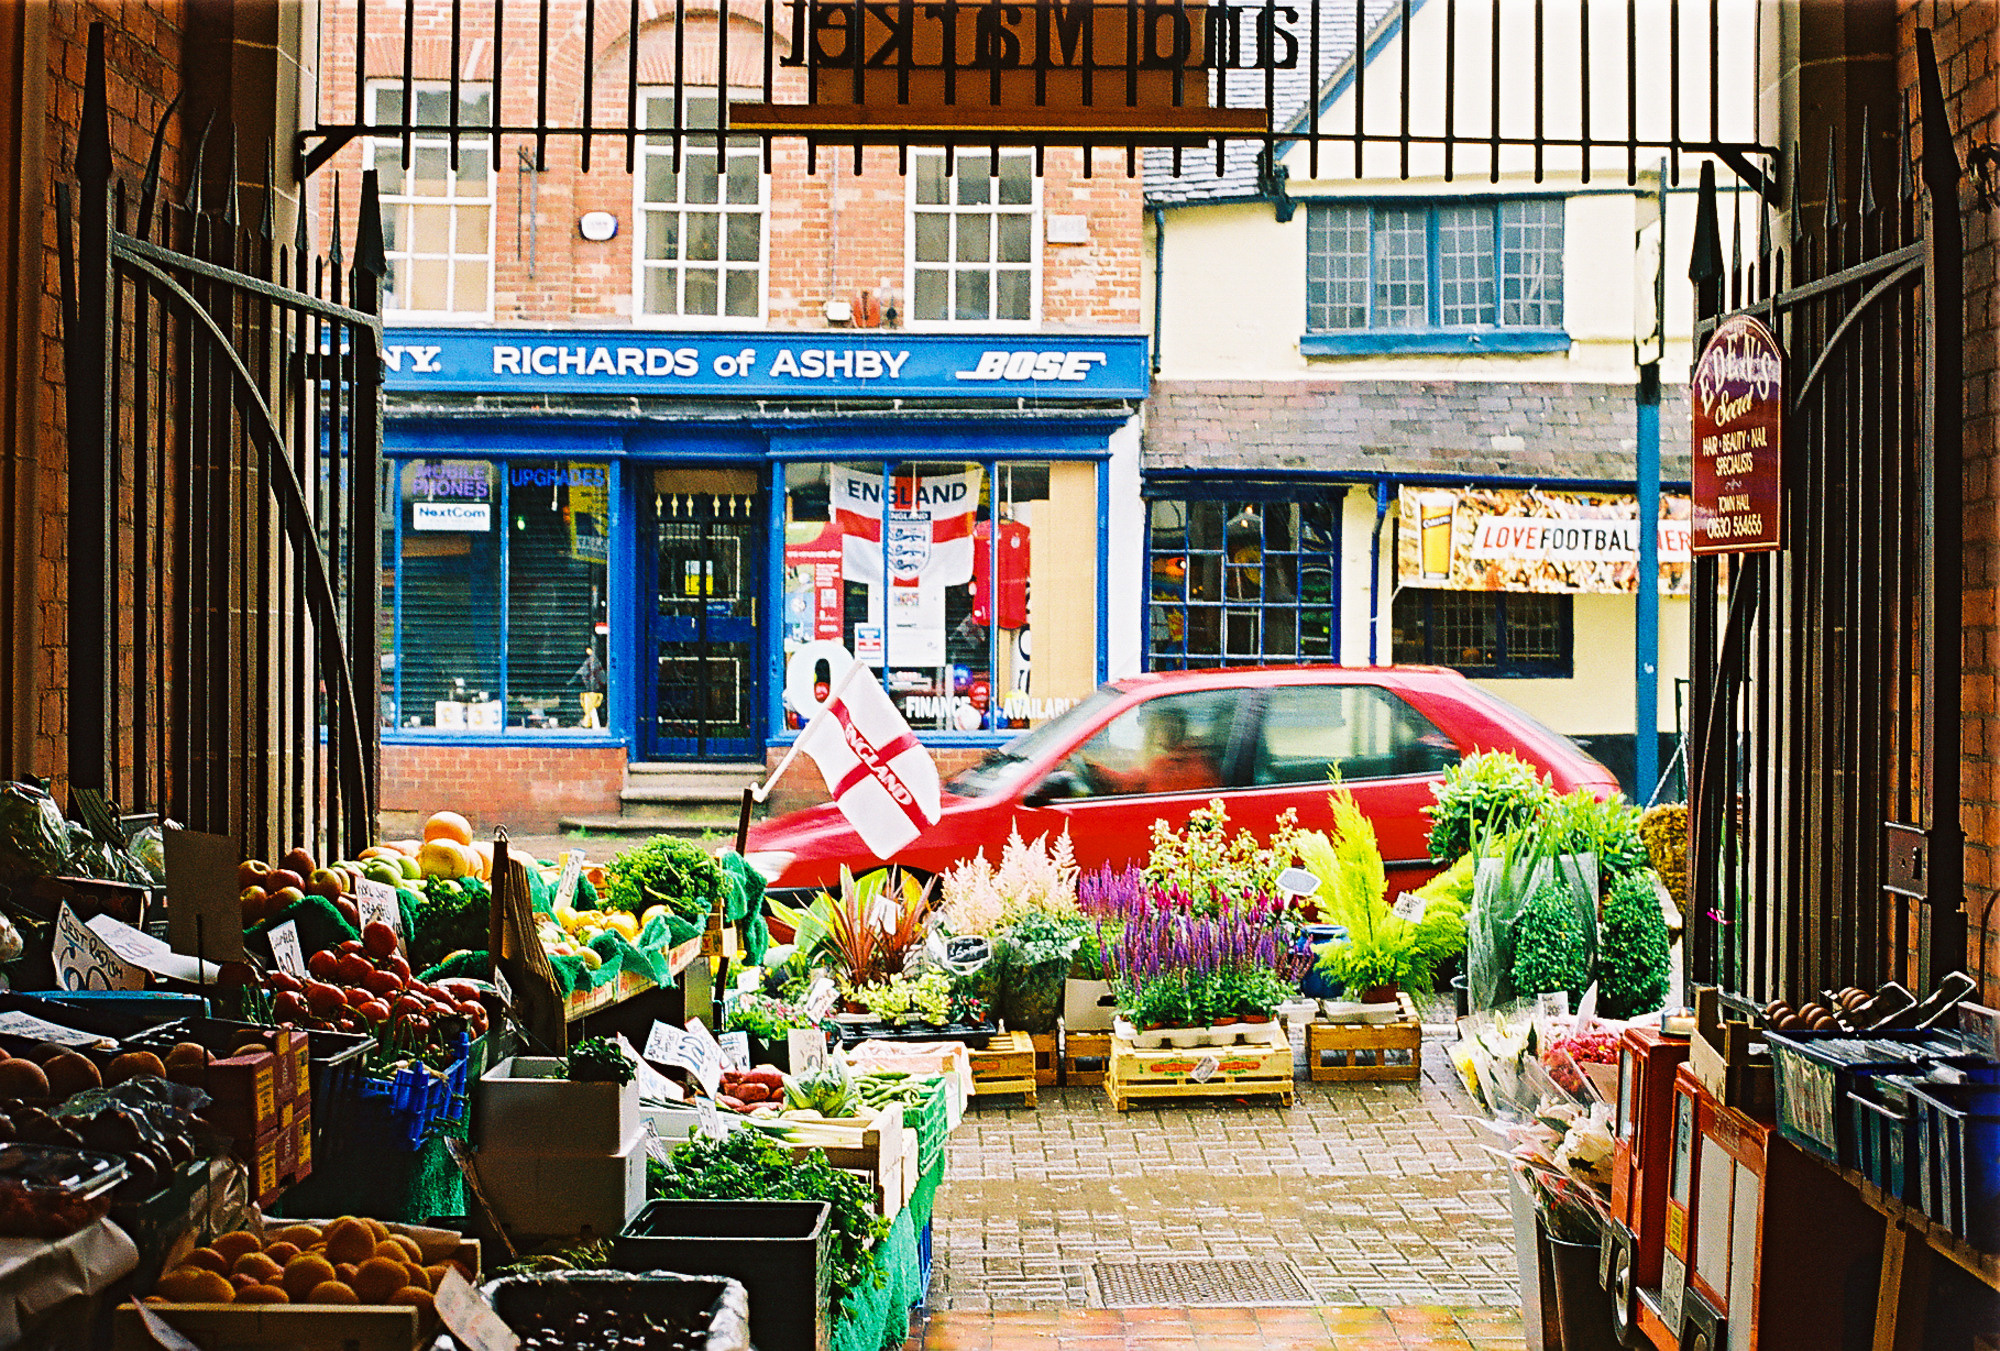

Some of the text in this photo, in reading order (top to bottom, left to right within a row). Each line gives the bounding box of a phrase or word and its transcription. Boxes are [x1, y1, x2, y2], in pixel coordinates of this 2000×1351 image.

[492, 346, 910, 379] RICHARDS of ASHBY
[956, 351, 1107, 381] BOSE
[1715, 384, 1754, 427] Secret
[1702, 426, 1768, 457] HAIR BEAUTY NAIL
[415, 463, 486, 480] MOBILE
[1715, 451, 1754, 477] SPECIALISTS
[413, 479, 489, 497] PHONES
[511, 469, 606, 488] UPGRADES
[847, 478, 968, 505] ENGLAND
[419, 506, 486, 518] NextCom
[1718, 493, 1751, 513] TOWN HALL
